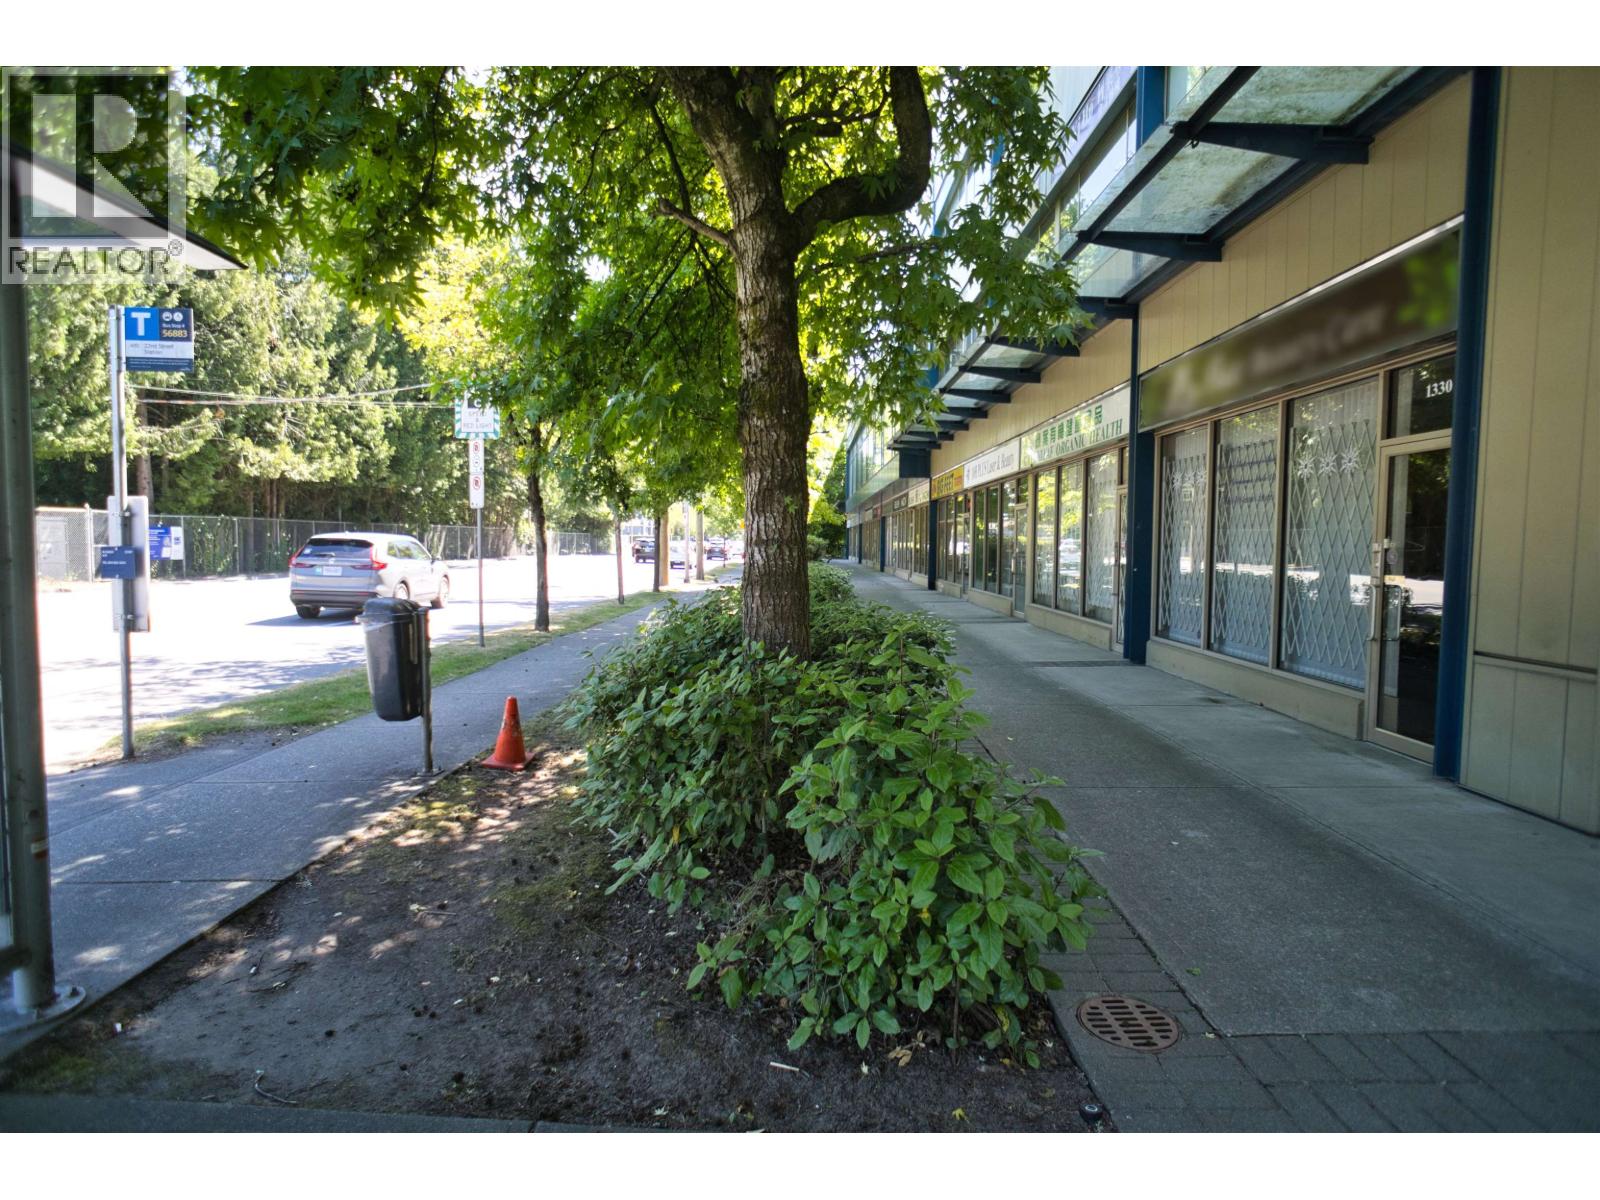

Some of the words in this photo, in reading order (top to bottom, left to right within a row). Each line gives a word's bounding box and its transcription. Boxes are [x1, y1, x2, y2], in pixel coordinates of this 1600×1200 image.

[131, 312, 151, 336] T
[162, 329, 188, 338] 56883
[1426, 379, 1453, 398] 1330
[1055, 431, 1086, 456] ORGANIC
[1088, 418, 1123, 445] HEALTH
